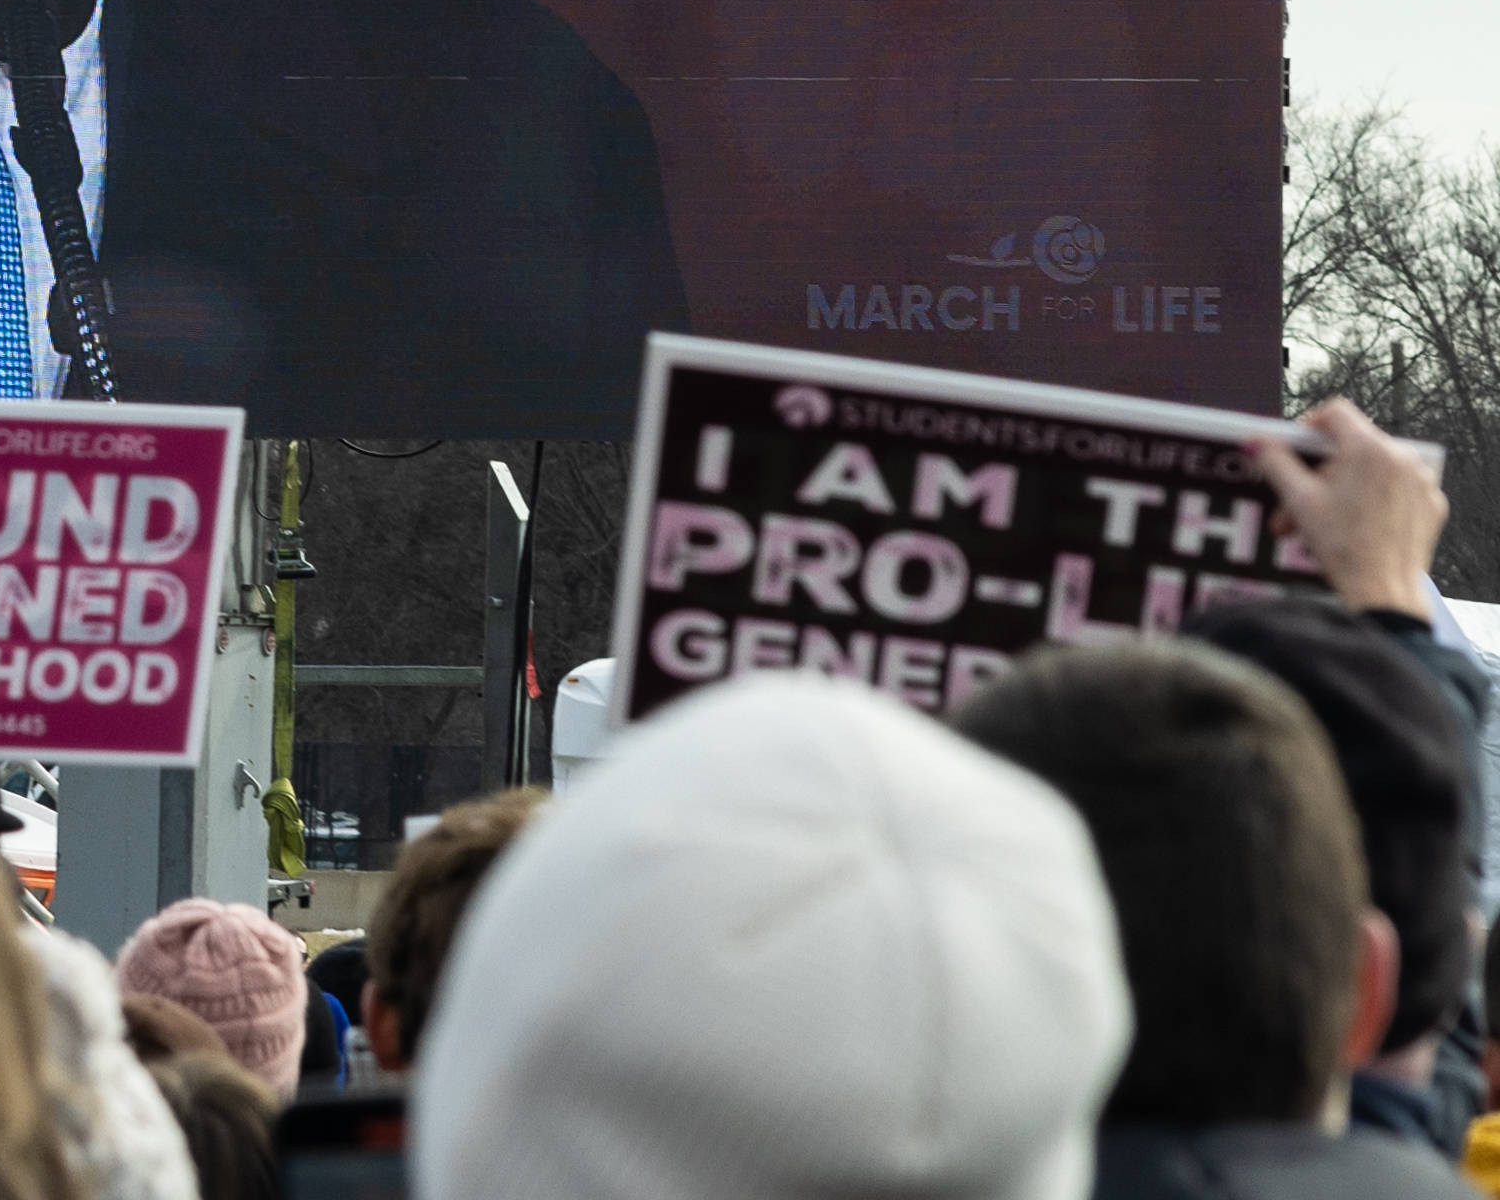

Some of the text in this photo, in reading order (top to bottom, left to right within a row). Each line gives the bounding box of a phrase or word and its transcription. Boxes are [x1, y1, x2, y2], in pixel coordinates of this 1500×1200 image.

[806, 283, 1222, 333] MARCH FOR LIFE
[697, 425, 734, 492] I
[798, 442, 1019, 530] AM
[837, 400, 1266, 483] STUDENTSFORLIFE.O
[648, 503, 1287, 643] PRO-LI
